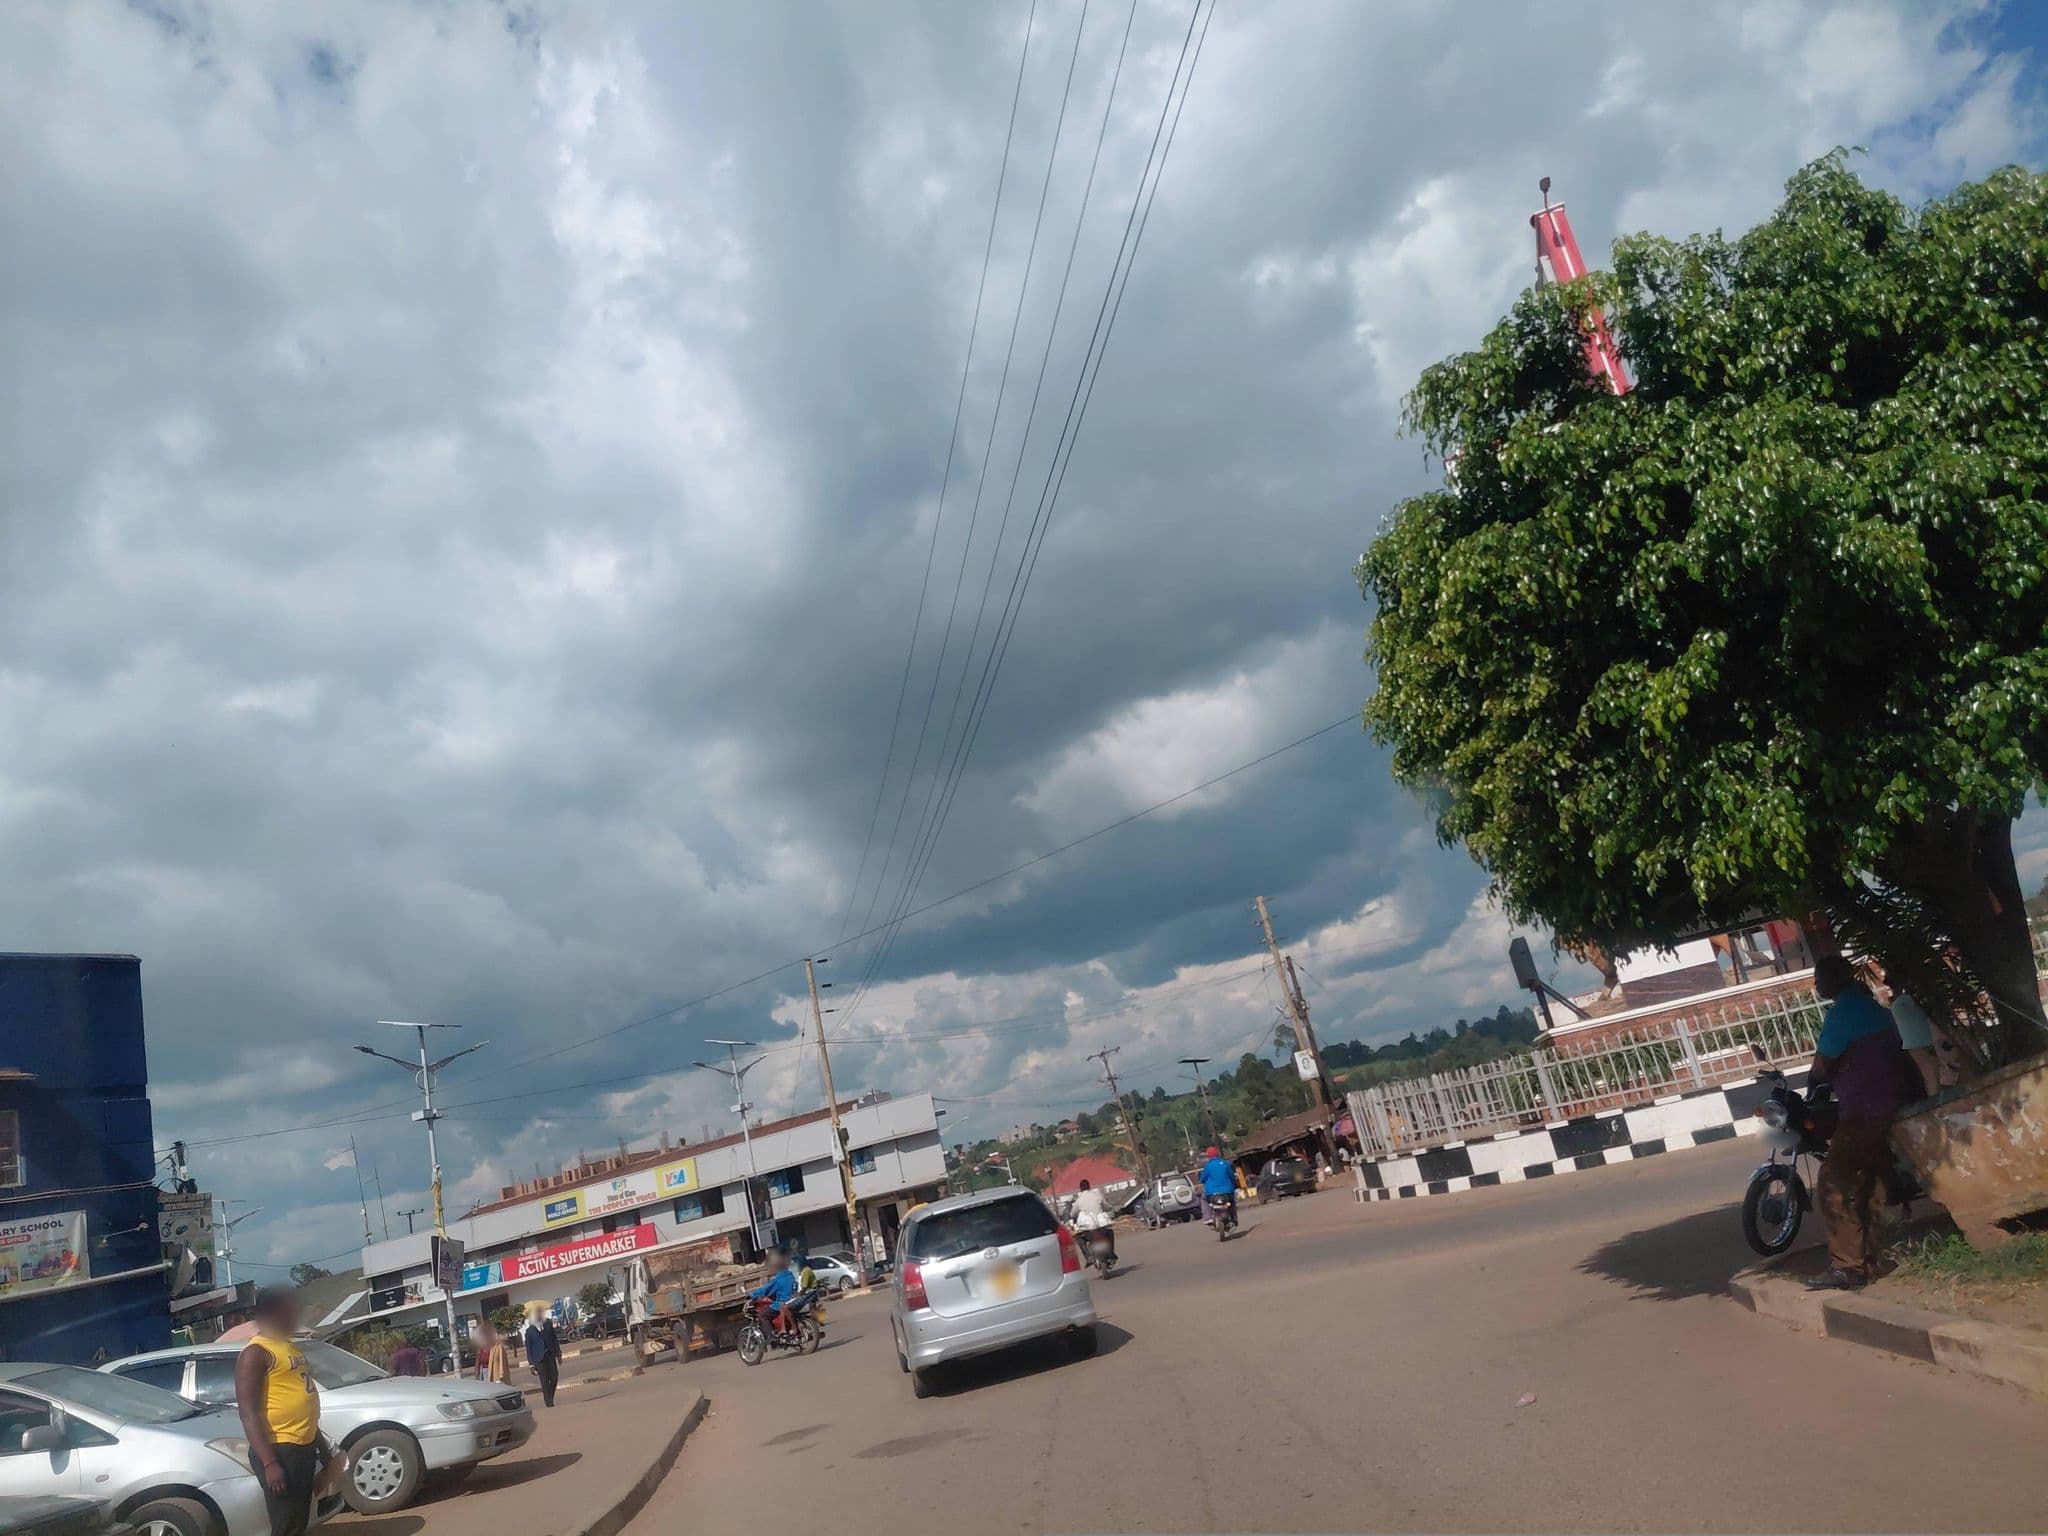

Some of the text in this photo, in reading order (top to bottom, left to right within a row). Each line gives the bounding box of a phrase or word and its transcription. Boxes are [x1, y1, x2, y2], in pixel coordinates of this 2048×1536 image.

[20, 1220, 64, 1233] SCHOOL
[518, 1255, 557, 1277] ACTIVE
[558, 1235, 637, 1267] SUPERMARKET
